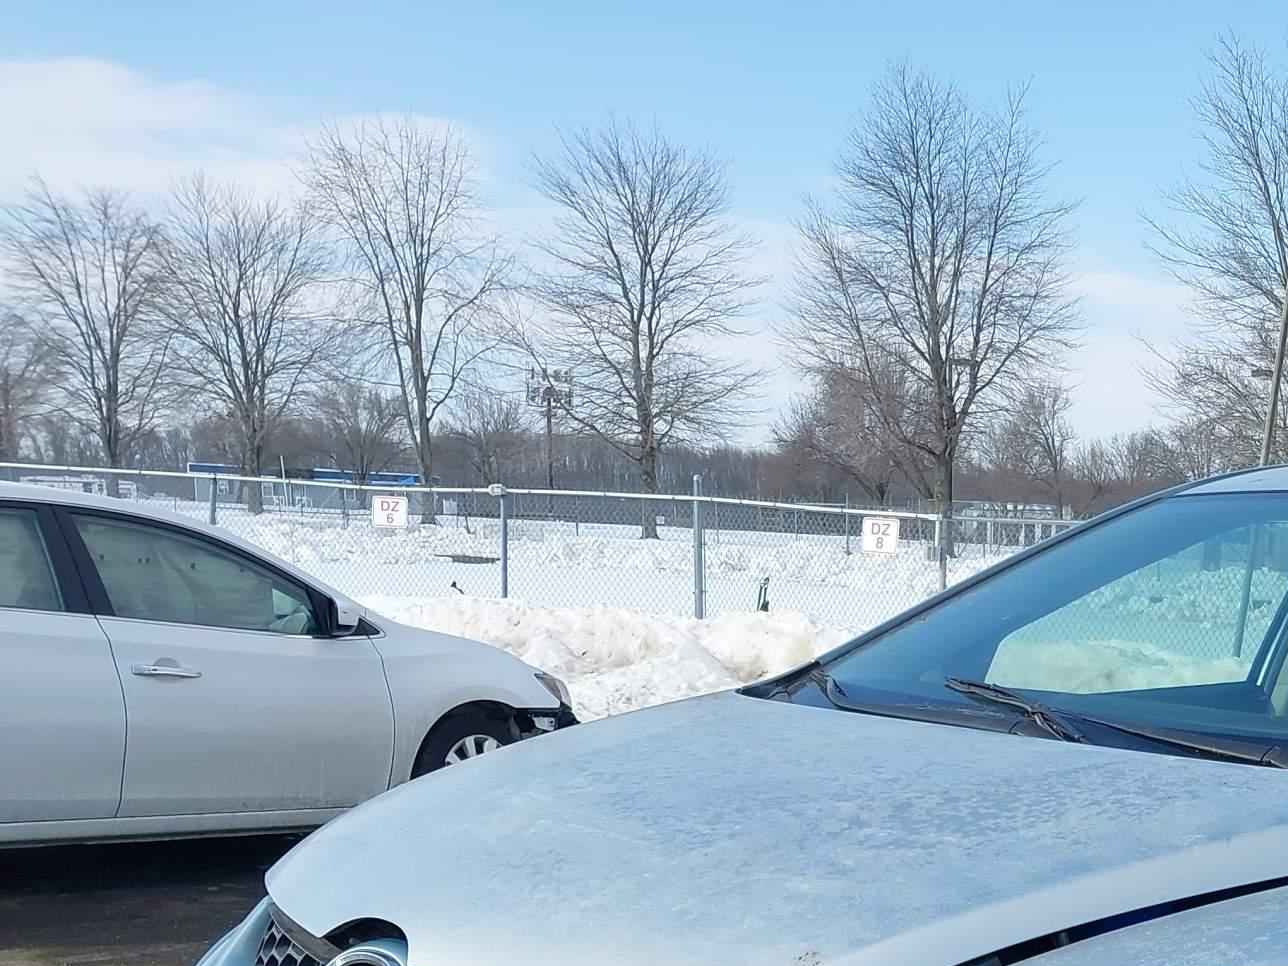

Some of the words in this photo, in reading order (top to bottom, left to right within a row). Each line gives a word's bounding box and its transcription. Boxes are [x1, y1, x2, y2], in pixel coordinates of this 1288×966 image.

[381, 500, 400, 512] DZ
[386, 513, 394, 524] 6
[871, 522, 891, 536] DZ
[875, 536, 884, 549] 8
